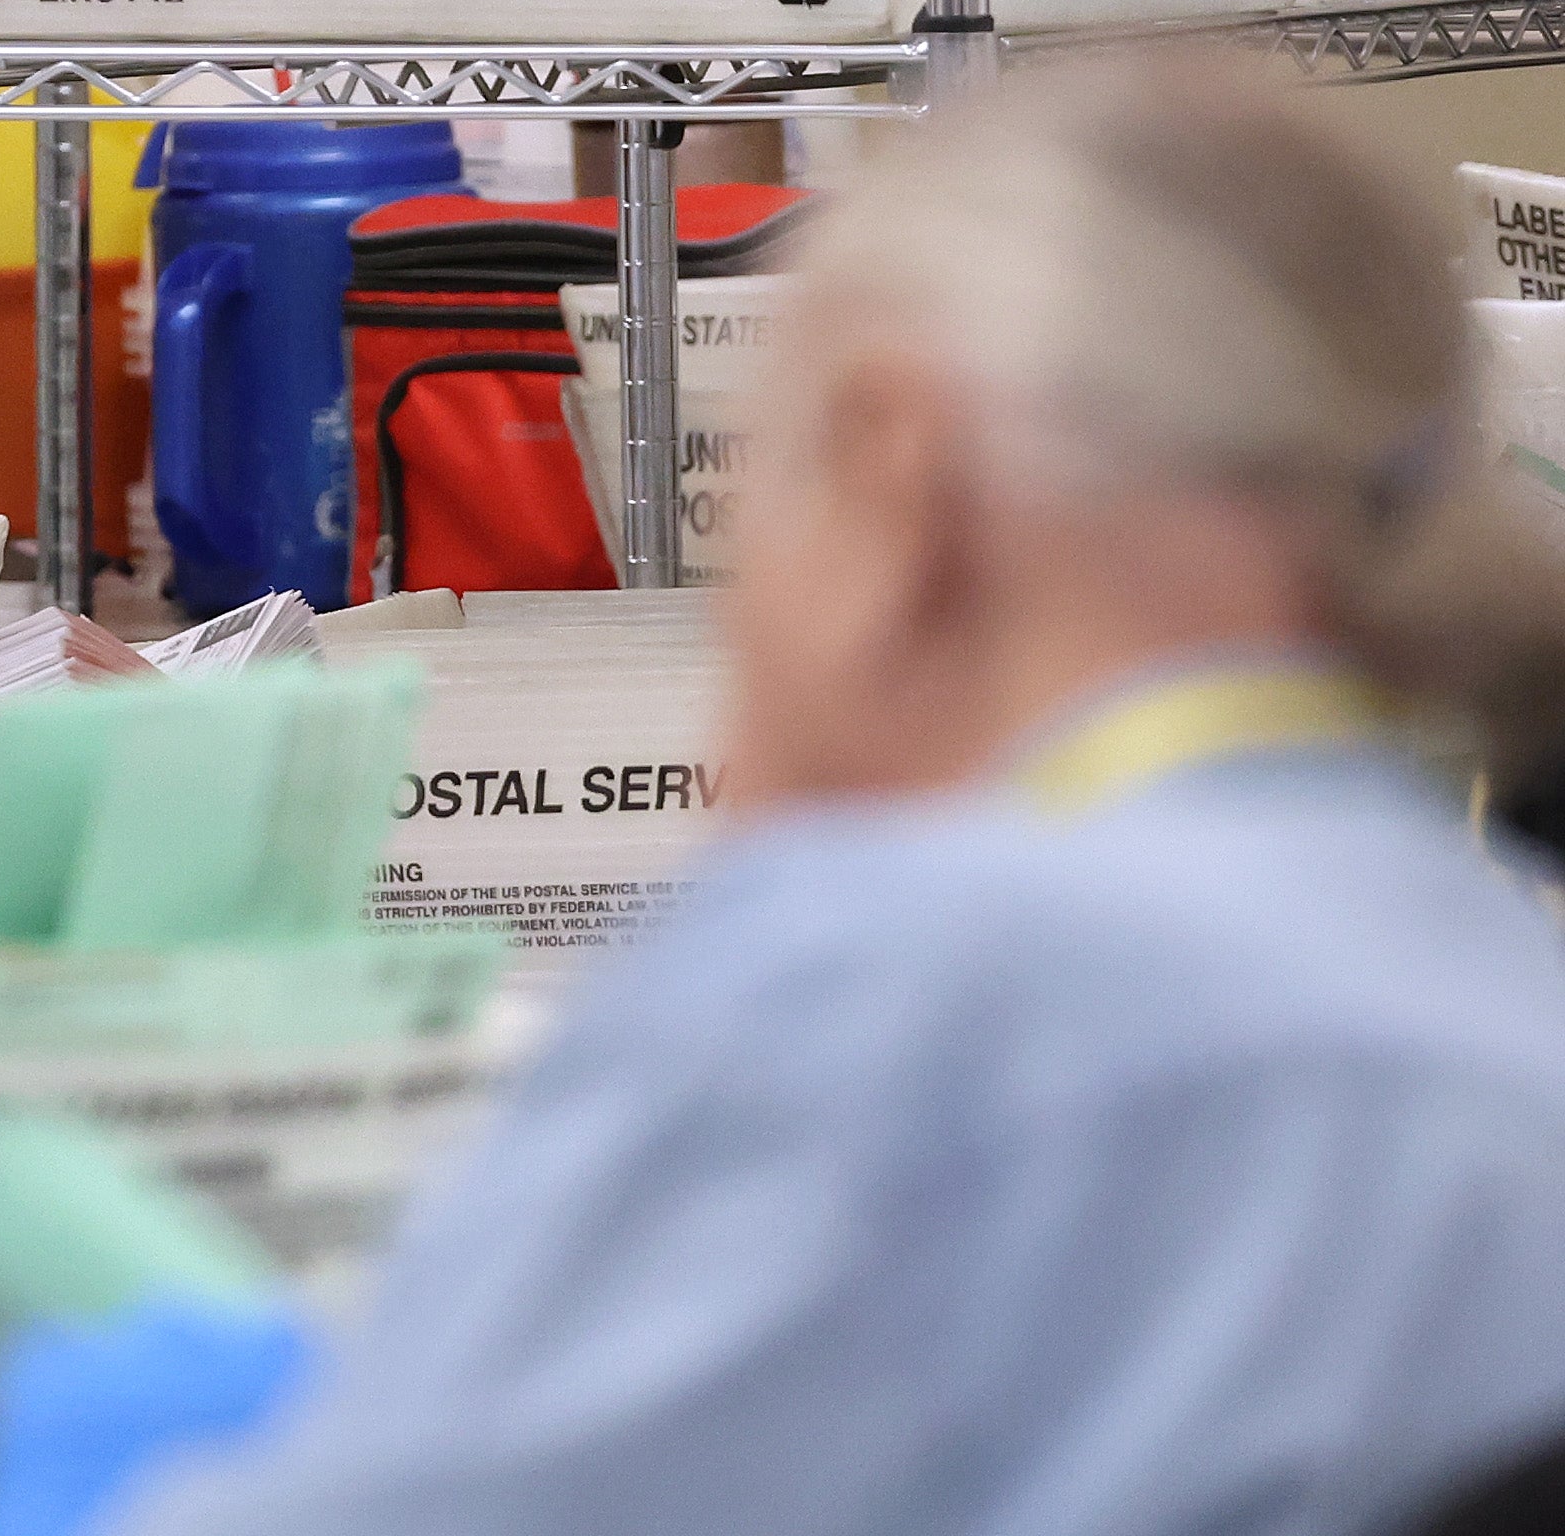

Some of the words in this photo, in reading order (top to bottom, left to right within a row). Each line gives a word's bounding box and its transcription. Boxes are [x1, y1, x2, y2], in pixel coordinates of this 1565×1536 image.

[1495, 197, 1565, 238] LABE
[1498, 236, 1565, 276] OTHE
[684, 316, 769, 347] STATE
[392, 768, 563, 820] OSTAL
[581, 764, 726, 814] SERV
[363, 887, 447, 903] PERMISSION
[450, 886, 469, 900] OF
[471, 886, 499, 900] THE
[501, 885, 521, 899] US
[524, 883, 575, 898] POSTAL
[375, 904, 438, 919] STRICTLY
[442, 902, 525, 918] PROHIBITED
[528, 901, 546, 915] BY
[550, 899, 612, 915] FEDERAL
